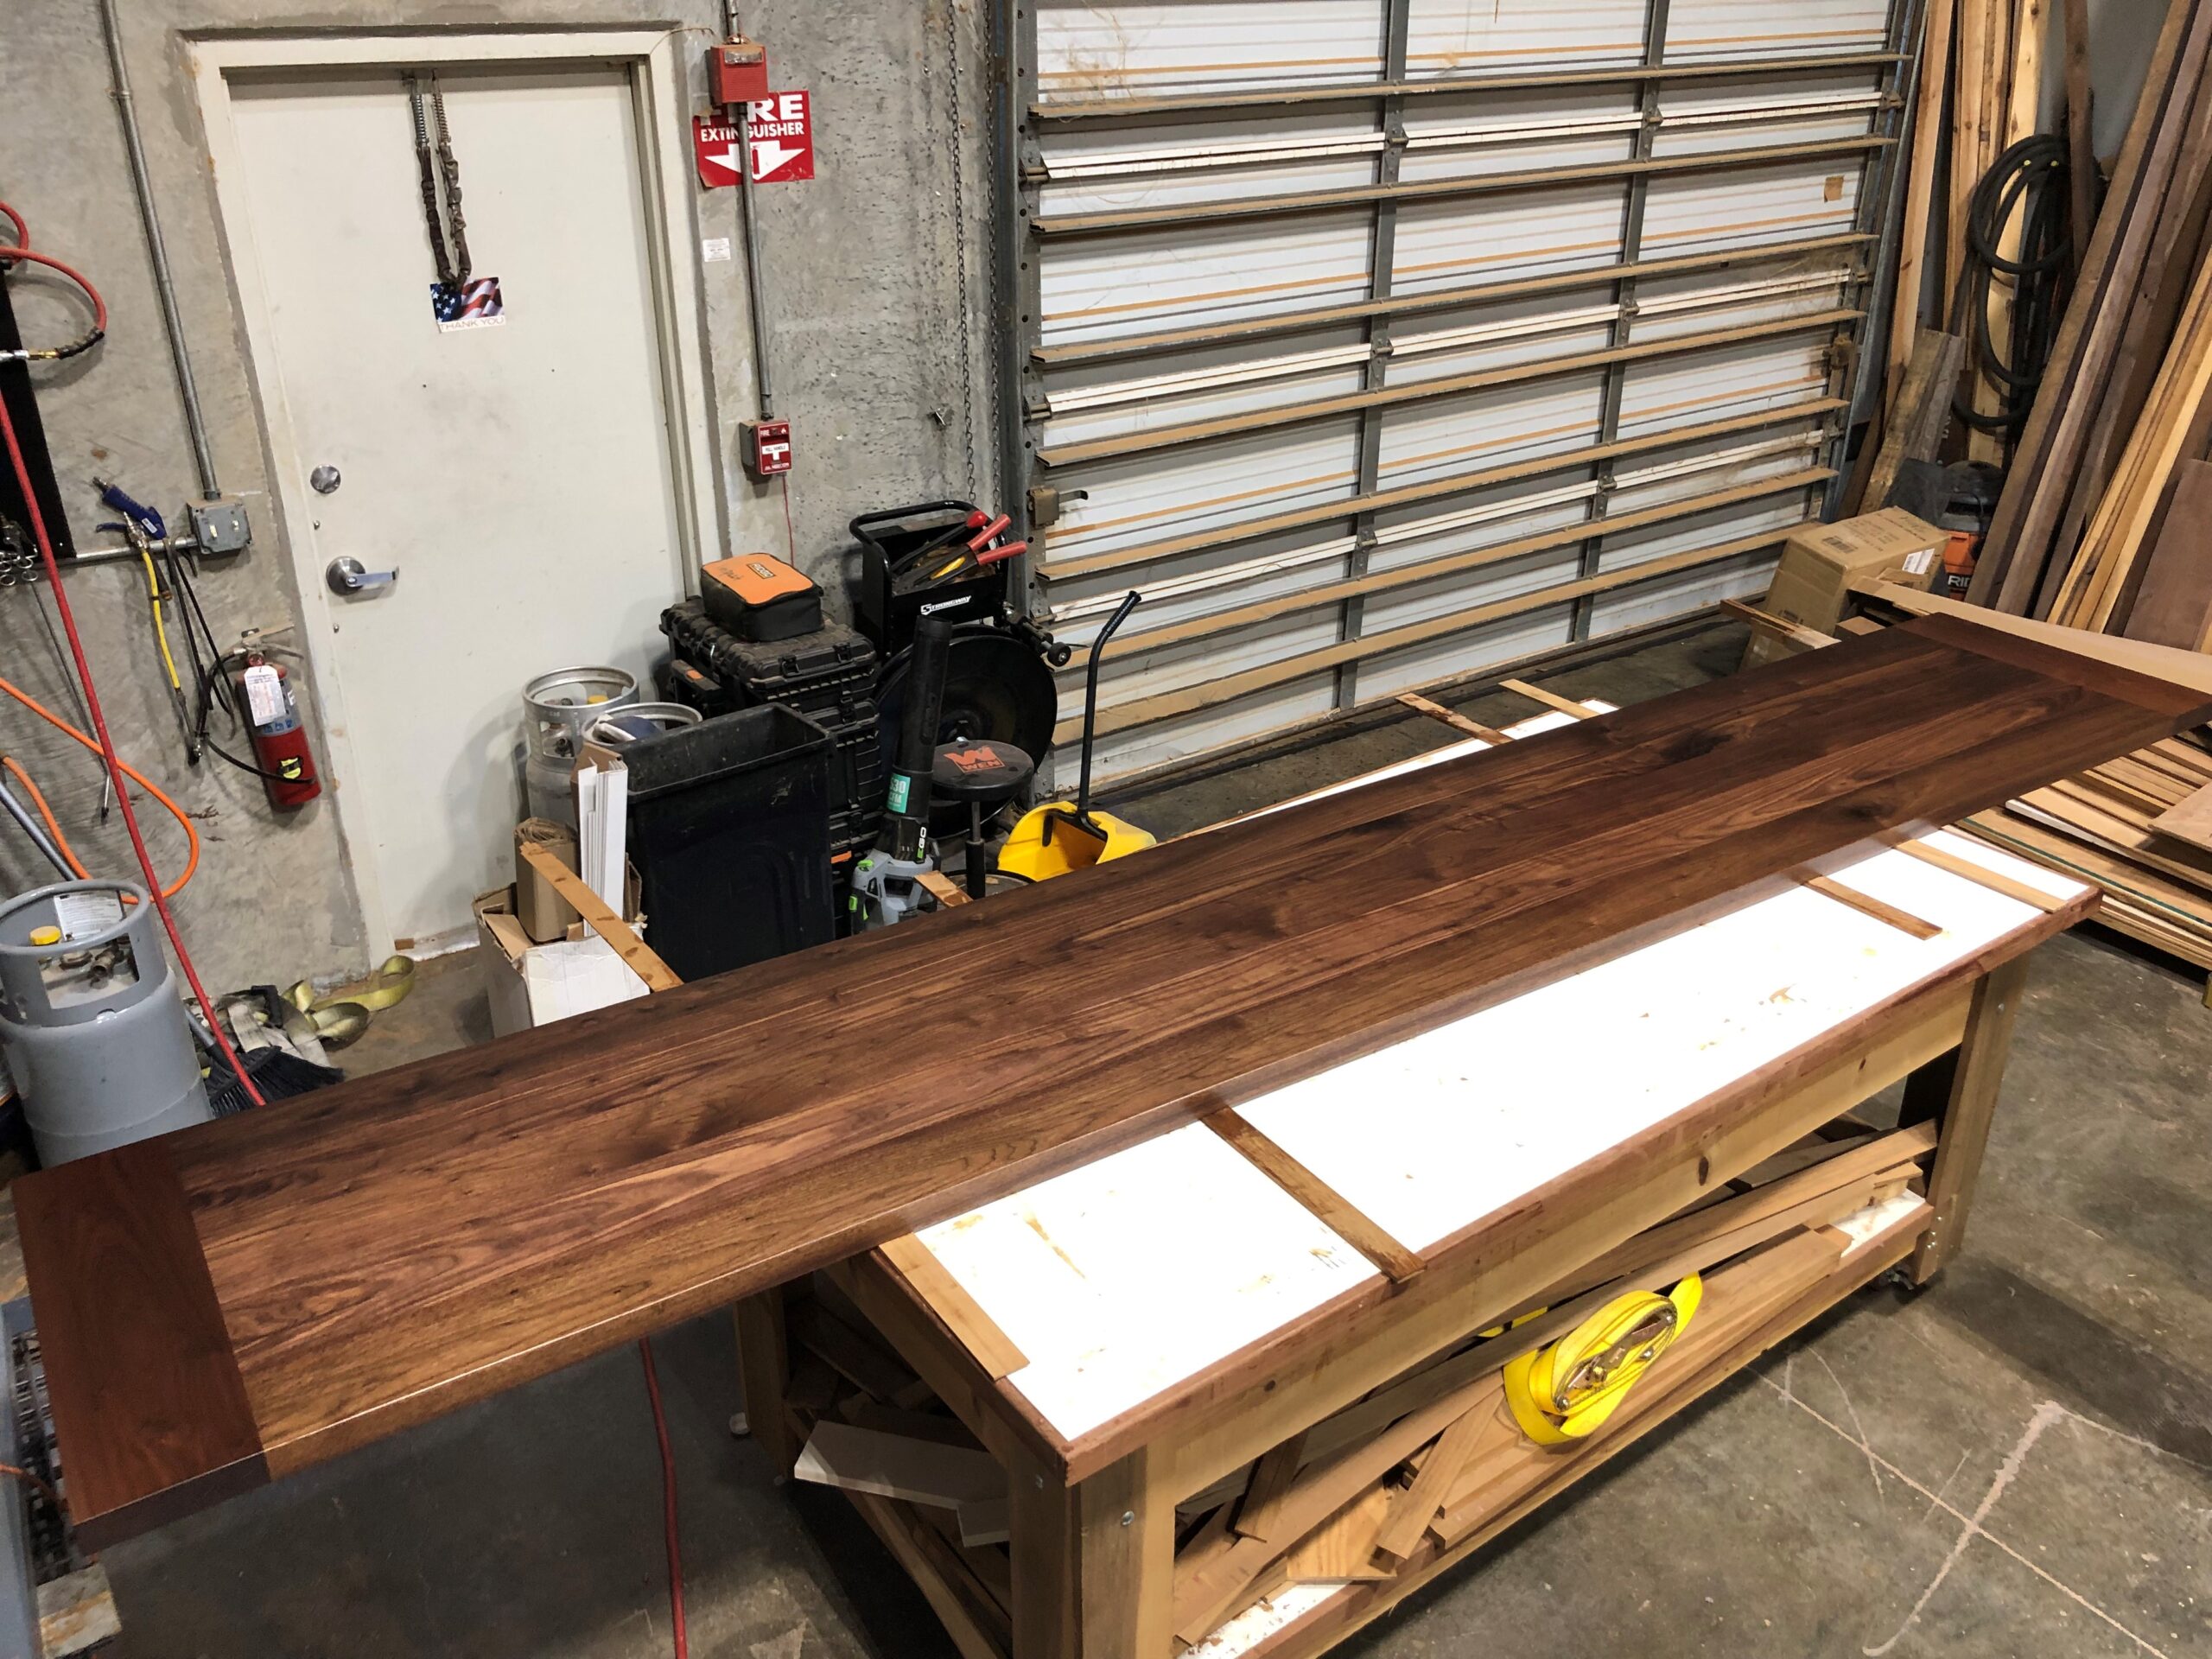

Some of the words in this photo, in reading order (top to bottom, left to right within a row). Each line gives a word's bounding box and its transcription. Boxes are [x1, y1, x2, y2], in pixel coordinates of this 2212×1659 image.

[700, 94, 804, 125] RE
[440, 320, 478, 332] THANK
[481, 316, 504, 326] YOU
[920, 595, 972, 616] STRONGWAY
